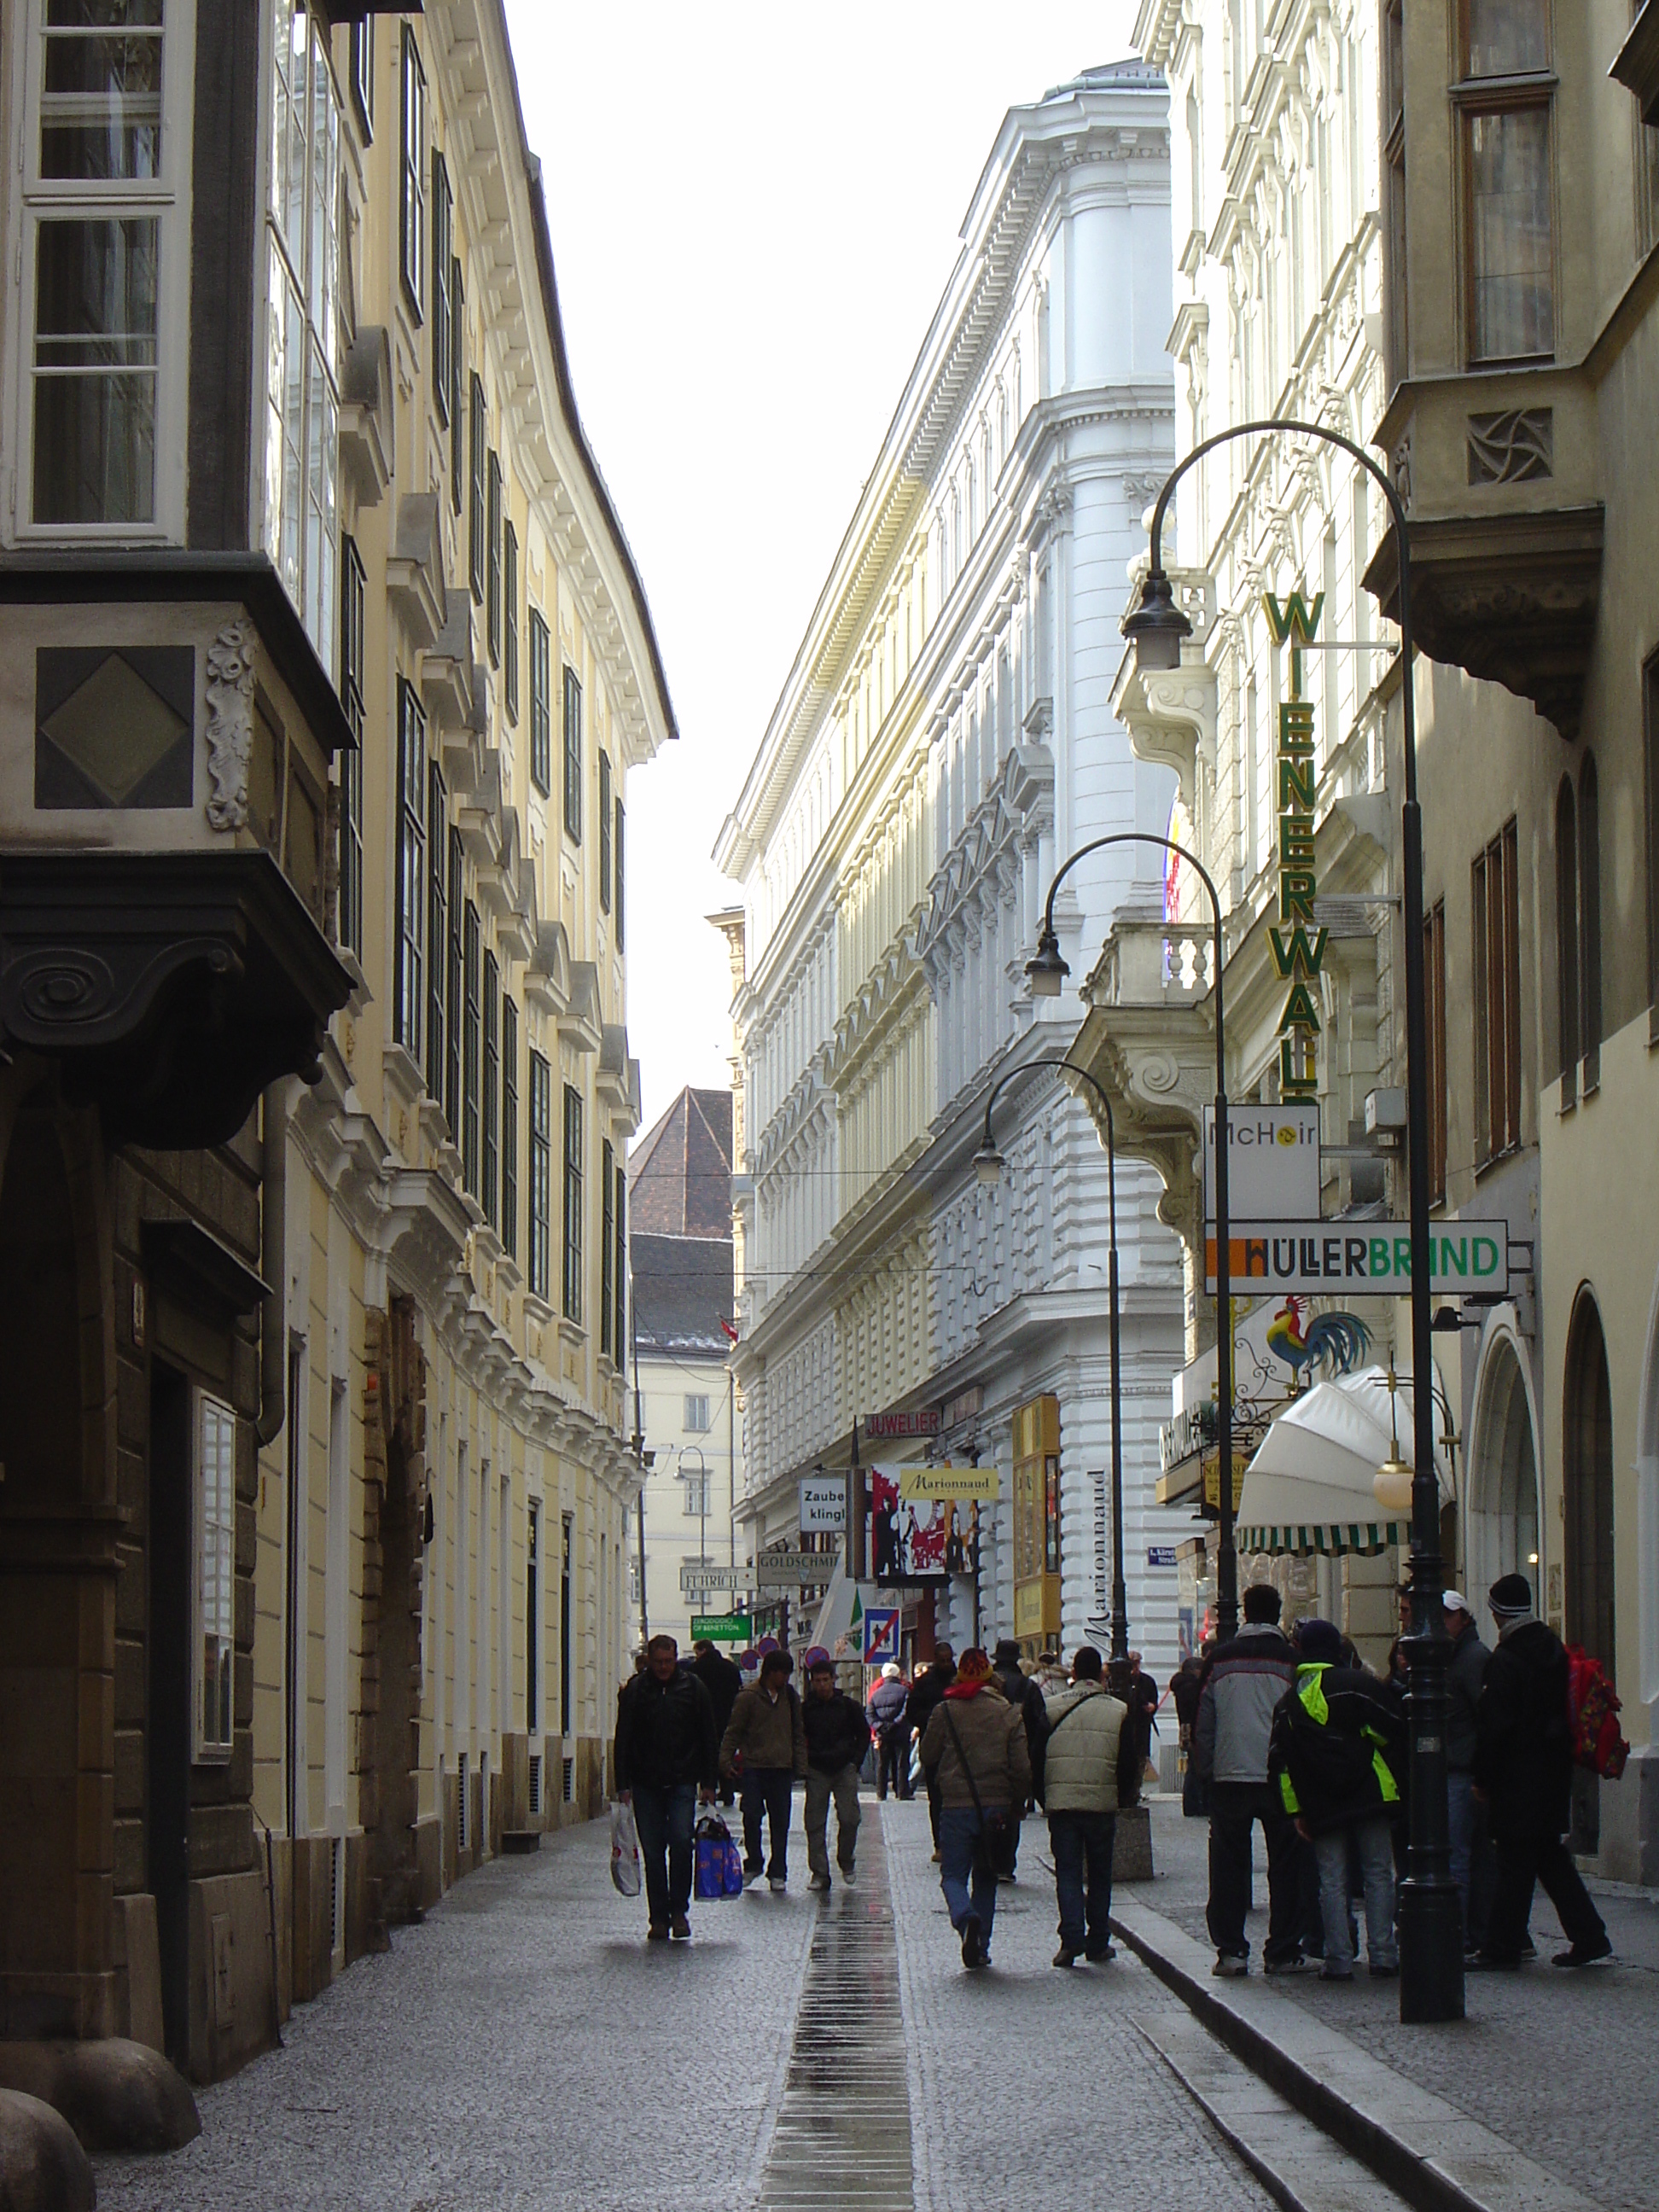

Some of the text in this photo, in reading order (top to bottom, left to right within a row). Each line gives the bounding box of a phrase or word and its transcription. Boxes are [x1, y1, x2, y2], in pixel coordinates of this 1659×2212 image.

[1260, 591, 1329, 1104] WIENERWAL
[867, 1412, 938, 1435] JUWELIER
[907, 1474, 990, 1494] Marionnaud
[1084, 1469, 1112, 1655] Marionnaud
